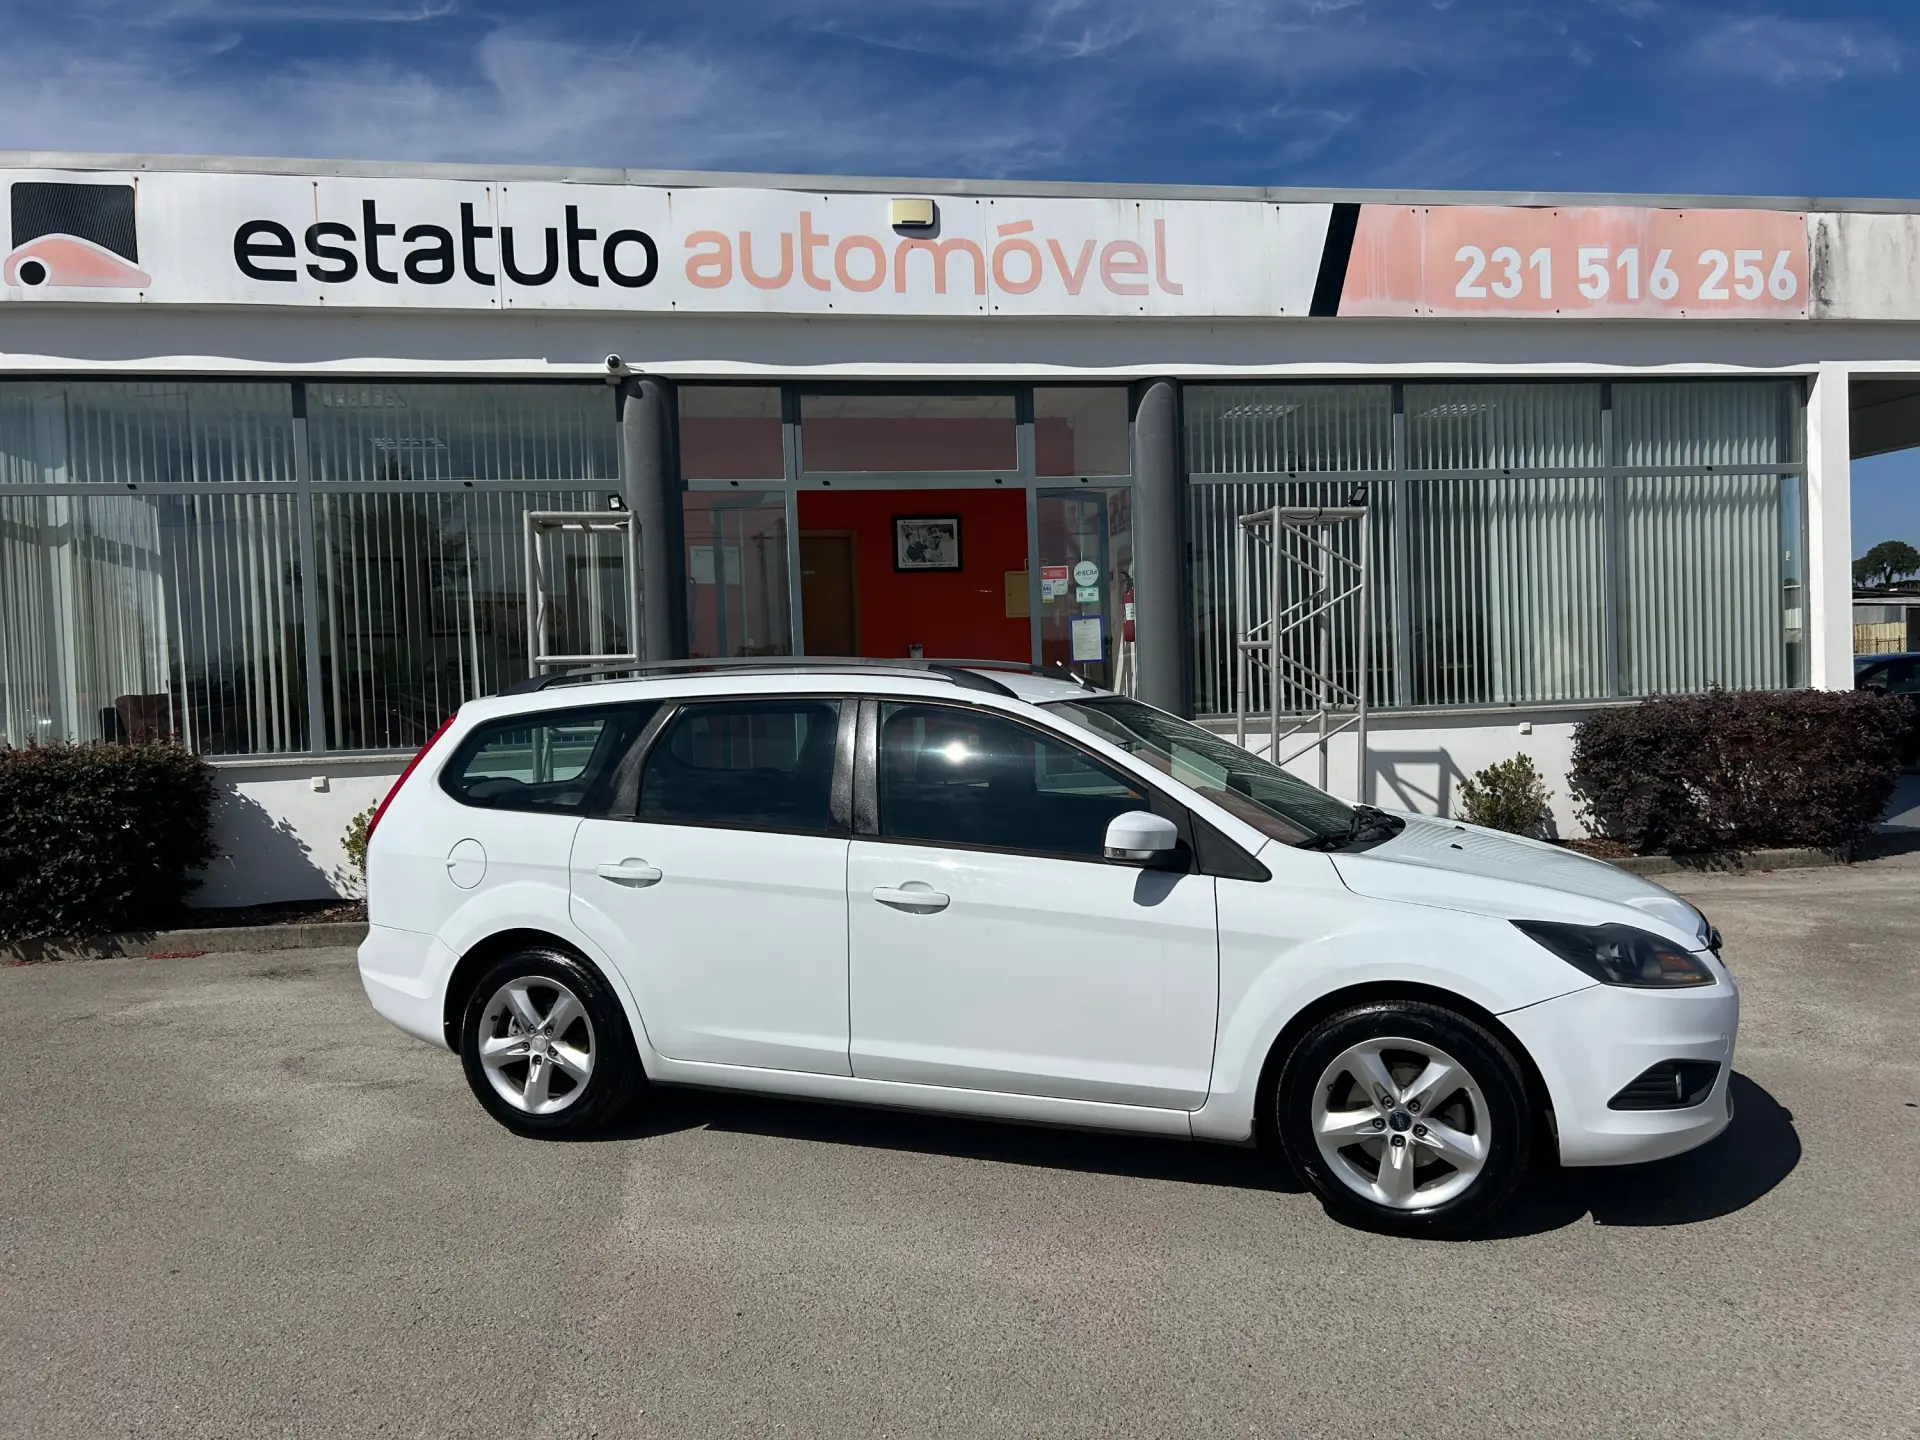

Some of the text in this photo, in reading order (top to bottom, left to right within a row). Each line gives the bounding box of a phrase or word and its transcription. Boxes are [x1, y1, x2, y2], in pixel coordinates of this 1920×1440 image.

[233, 199, 1183, 296] estatuto automóvel
[1454, 245, 1798, 302] 231 516 256
